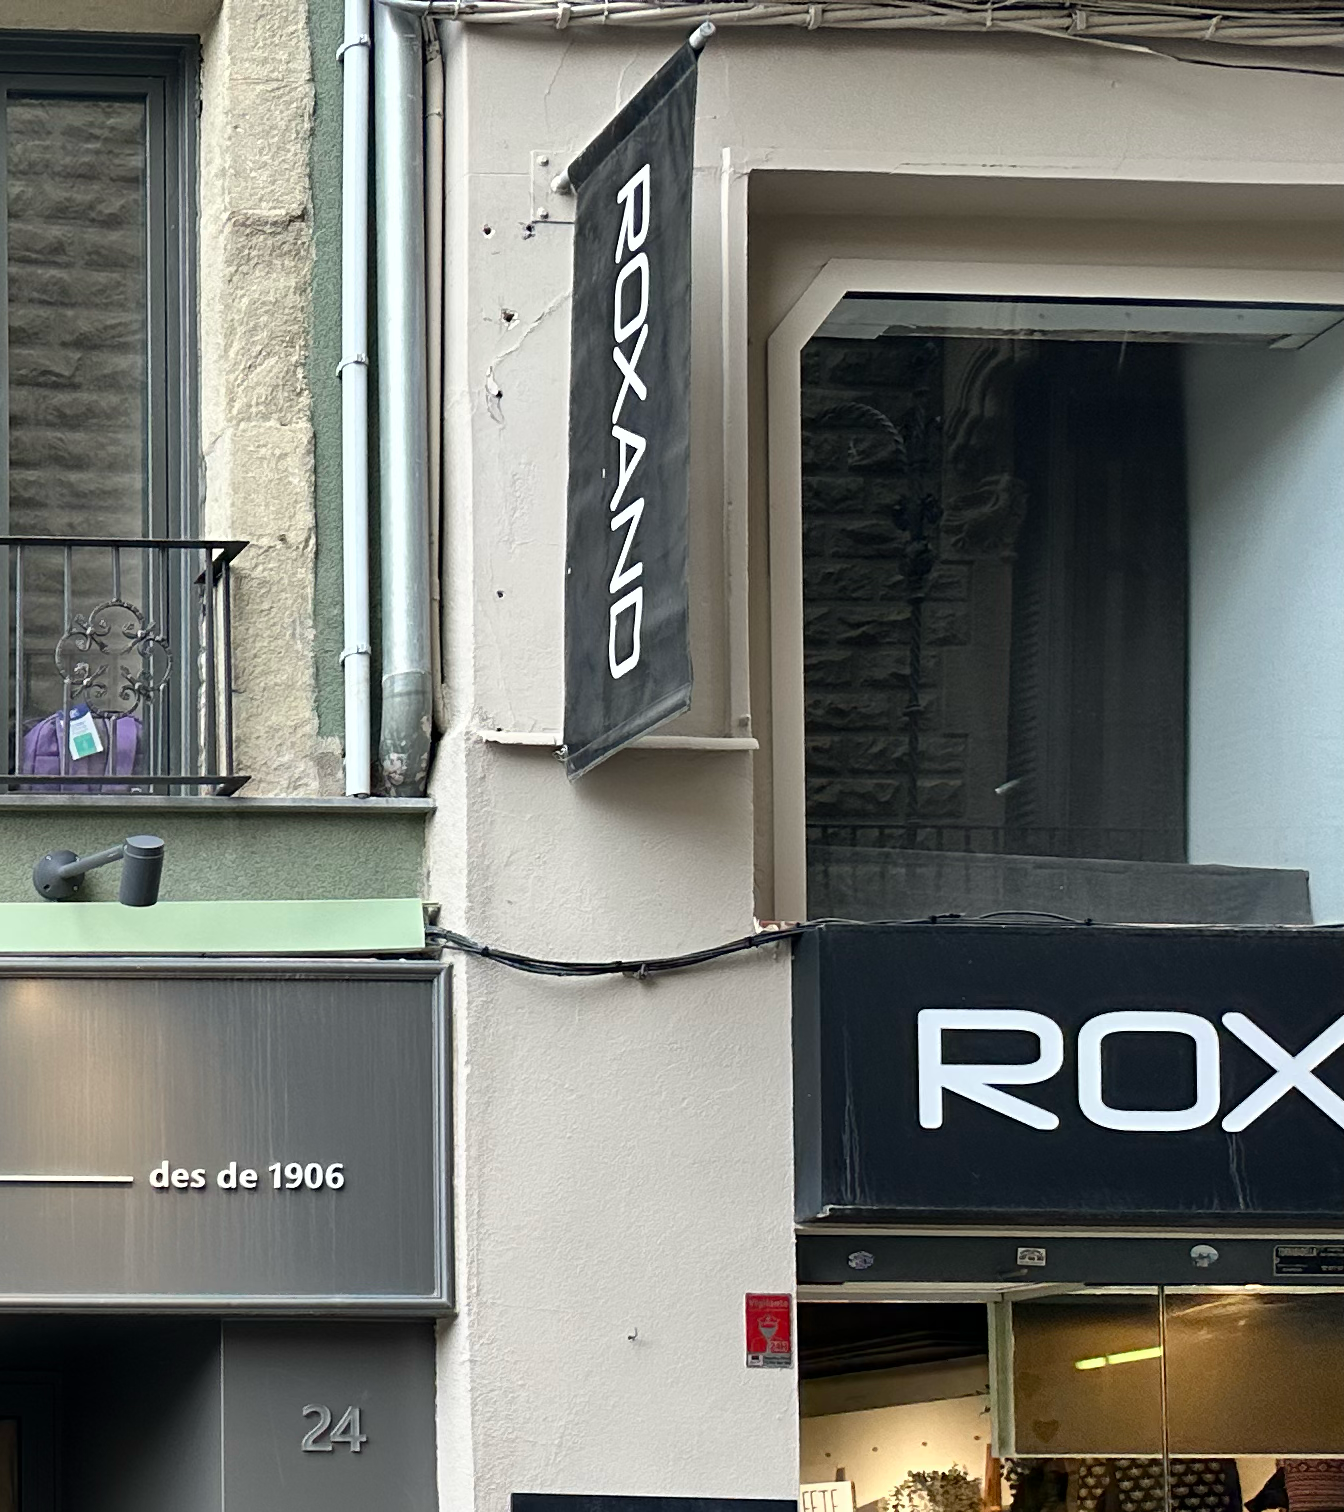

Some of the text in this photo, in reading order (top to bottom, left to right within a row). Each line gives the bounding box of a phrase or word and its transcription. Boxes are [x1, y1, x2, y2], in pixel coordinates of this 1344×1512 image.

[607, 163, 652, 680] ROXAND
[917, 1009, 1344, 1133] ROX
[149, 1160, 345, 1191] des de 1906
[301, 1405, 367, 1452] 24
